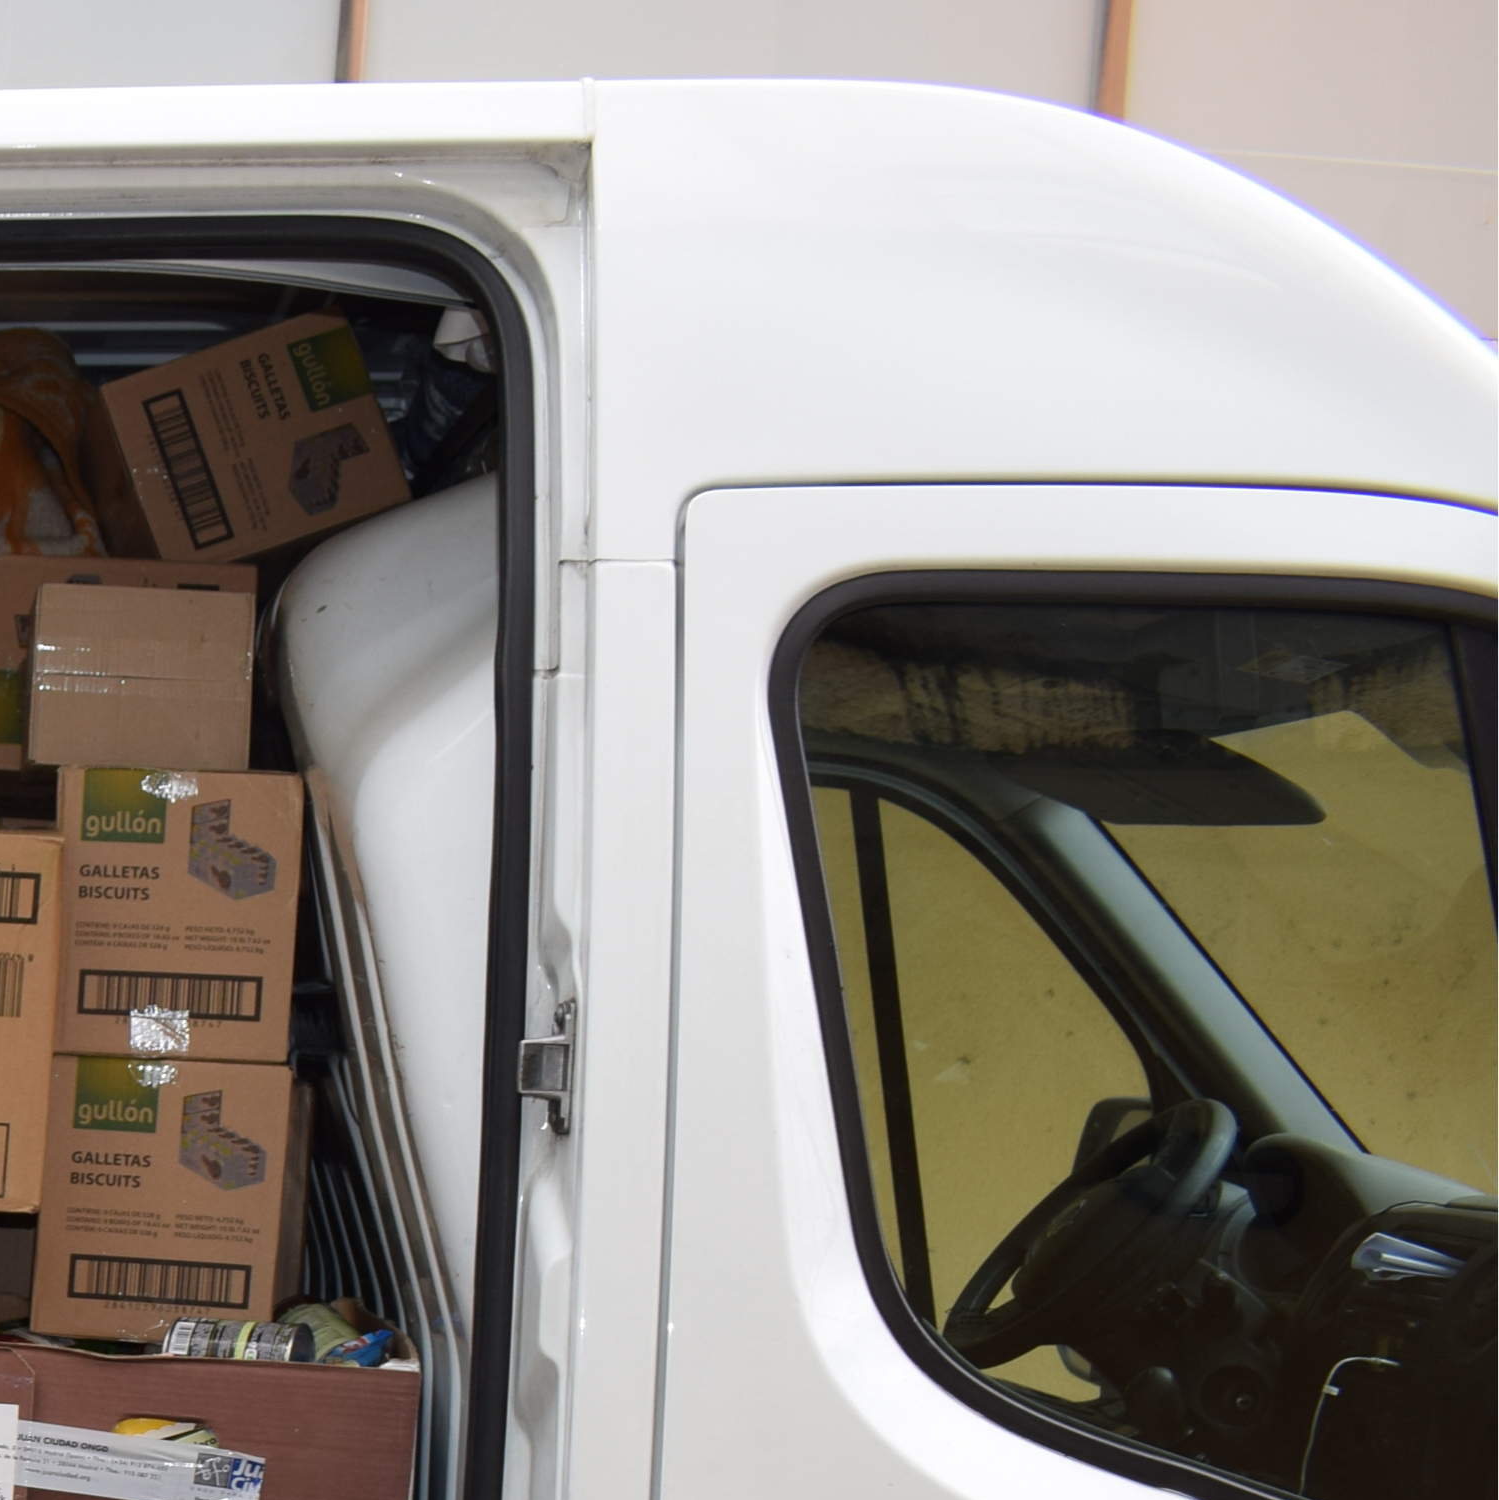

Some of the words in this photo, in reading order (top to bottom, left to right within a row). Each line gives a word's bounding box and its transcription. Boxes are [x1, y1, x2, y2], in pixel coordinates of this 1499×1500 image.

[294, 343, 331, 406] gullón
[240, 359, 269, 420] BISCUITS
[258, 353, 290, 421] GALLETAS
[86, 810, 161, 837] gullón
[80, 864, 160, 880] GALLETAS
[79, 885, 149, 900] BISCUITS
[79, 1099, 153, 1126] gullón
[72, 1151, 152, 1168] GALLETAS
[70, 1172, 140, 1188] BISCUITS
[17, 1433, 41, 1444] JUAN
[44, 1436, 78, 1449] CIUDAD
[80, 1442, 109, 1453] ONGD
